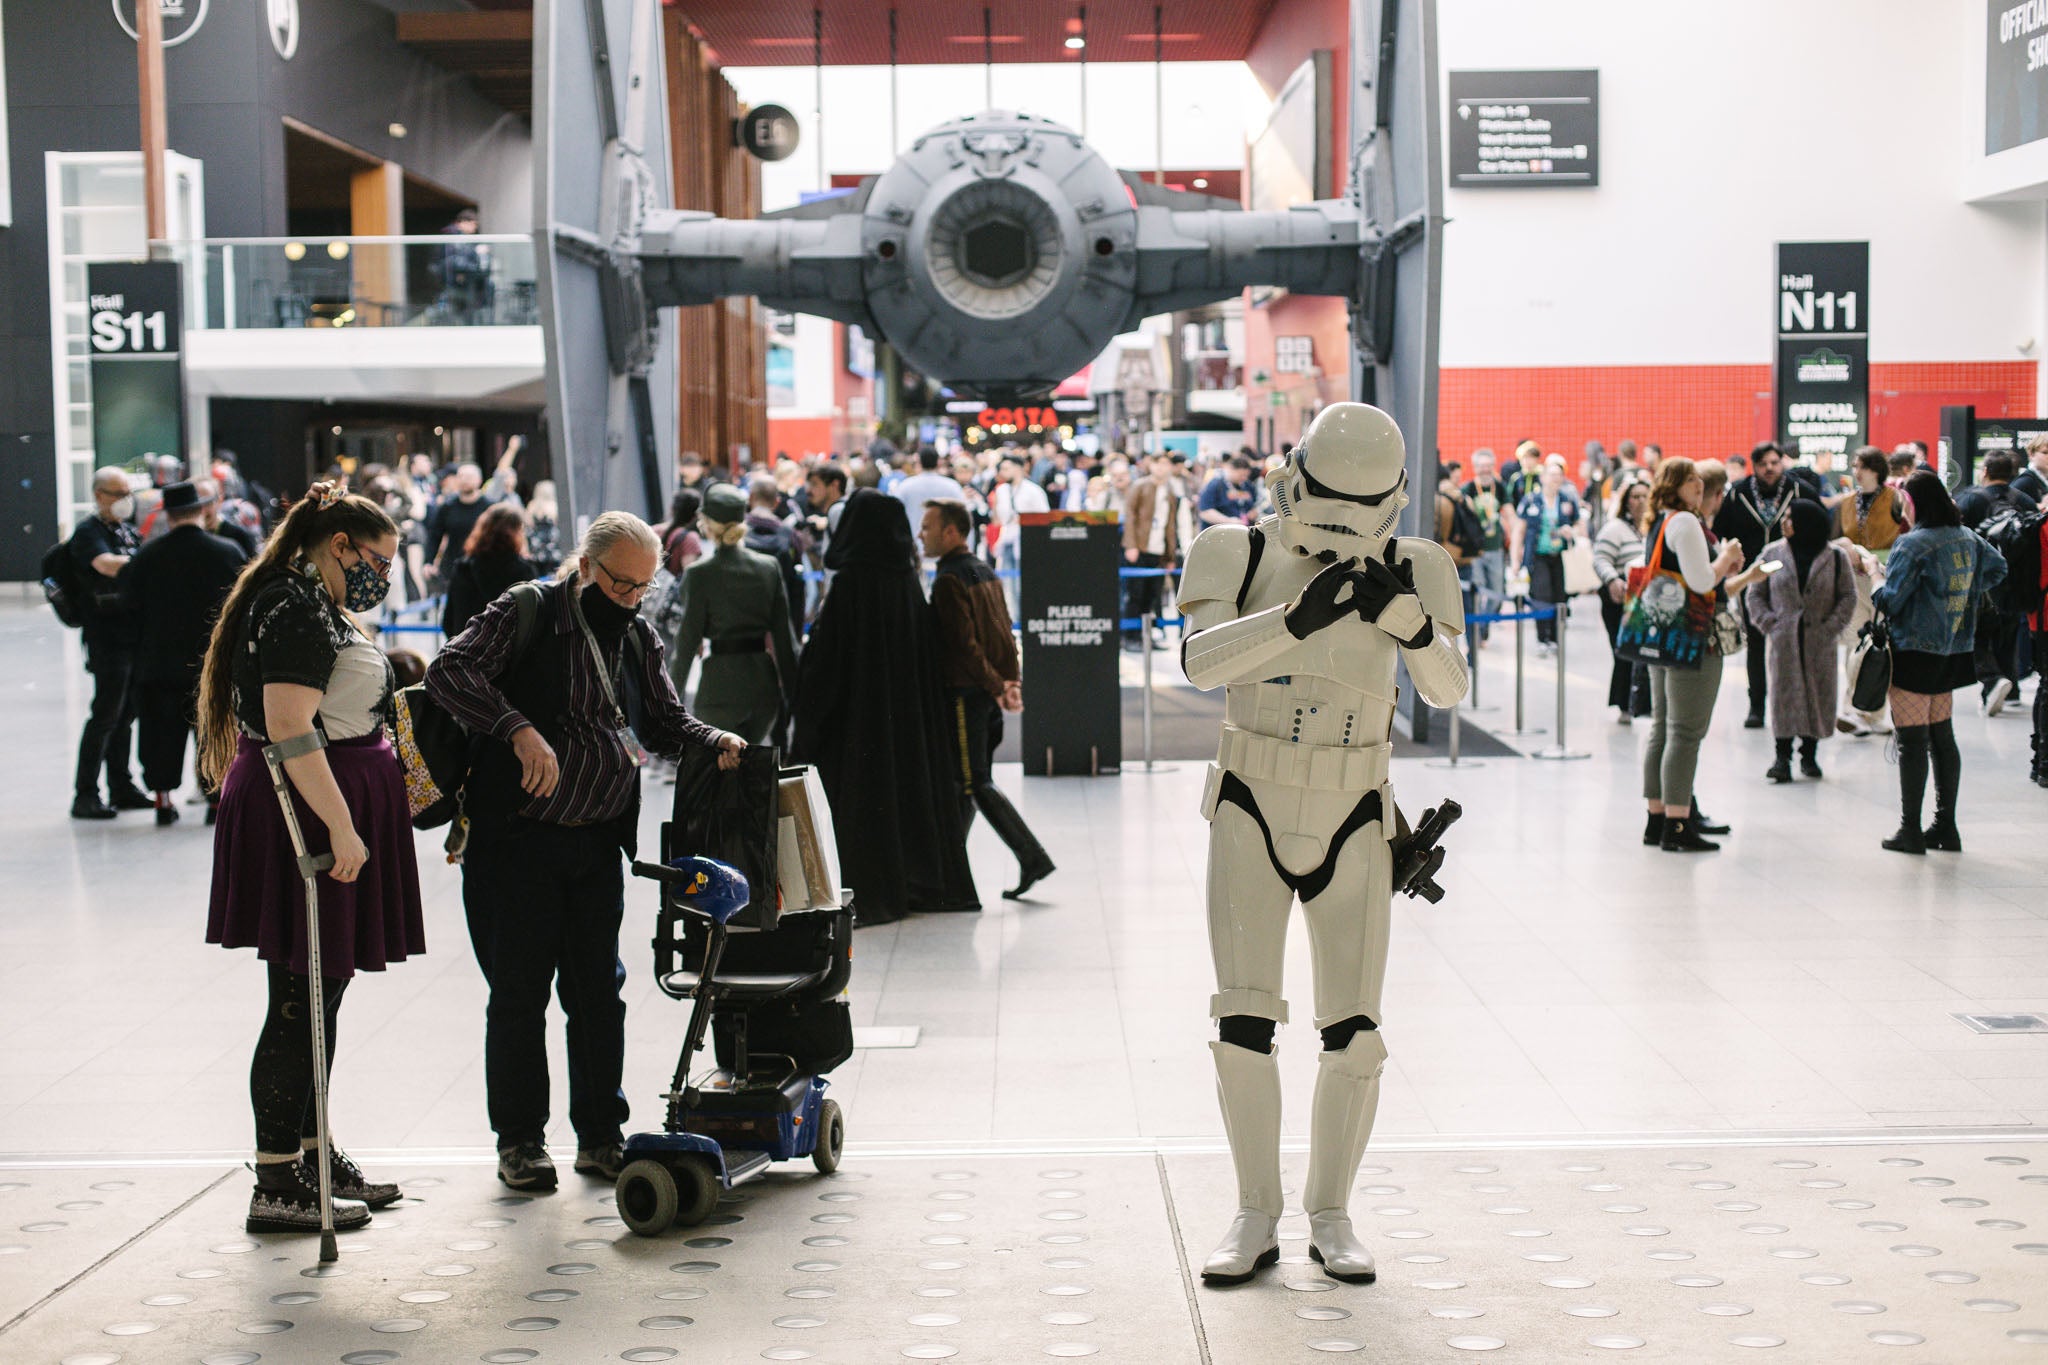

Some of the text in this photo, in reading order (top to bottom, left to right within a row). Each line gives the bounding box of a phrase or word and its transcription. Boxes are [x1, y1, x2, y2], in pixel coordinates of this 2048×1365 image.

[2000, 0, 2048, 44] OFFICIA
[1782, 275, 1813, 290] Hall
[91, 294, 124, 311] Hall
[1781, 291, 1856, 330] N11
[92, 311, 166, 352] S11
[977, 407, 1059, 431] COSTA
[1789, 403, 1858, 421] OFFICIAL
[1047, 605, 1092, 618] PLEASE
[1027, 618, 1113, 632] DO NOT TOUCH
[1038, 632, 1103, 645] THE PROPS
